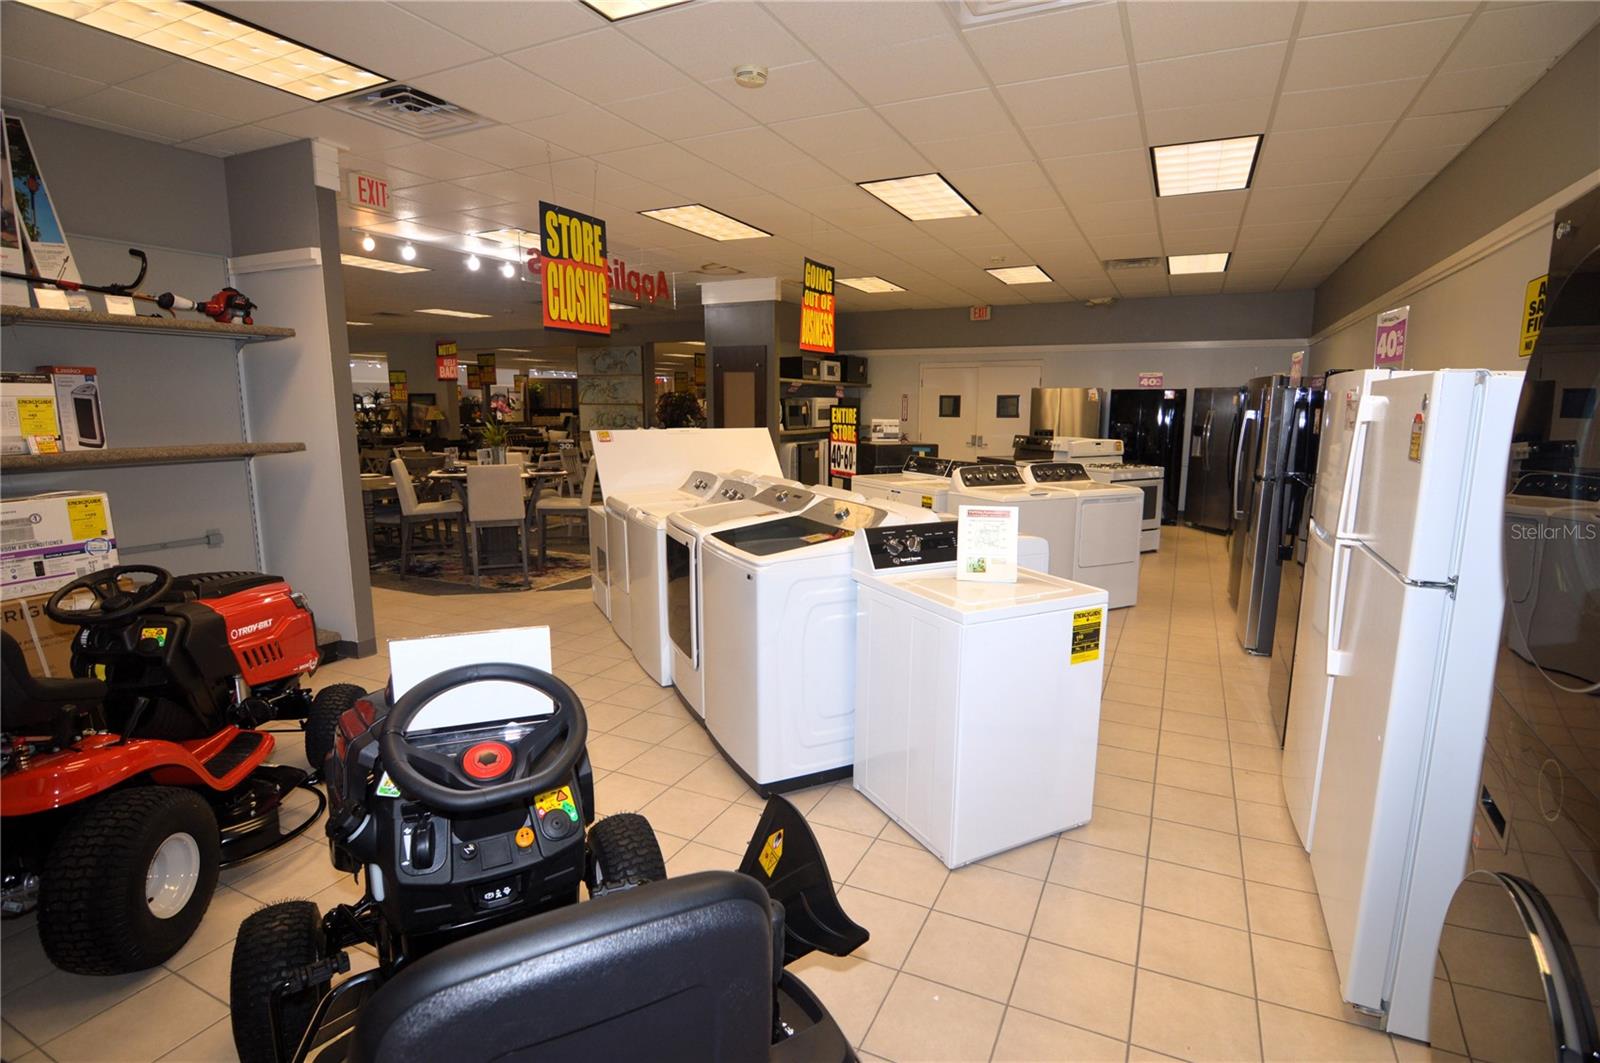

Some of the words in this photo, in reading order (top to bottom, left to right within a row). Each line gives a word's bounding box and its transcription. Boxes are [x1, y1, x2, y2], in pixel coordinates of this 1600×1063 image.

[358, 175, 387, 208] EXIT
[545, 210, 604, 267] STORE
[805, 262, 833, 293] GOING
[547, 261, 608, 327] CLOSING
[804, 290, 820, 308] OUT
[820, 294, 832, 310] OF
[831, 407, 857, 425] ENTIRE
[832, 424, 857, 441] STORE
[238, 618, 273, 636] TROY-BILT
